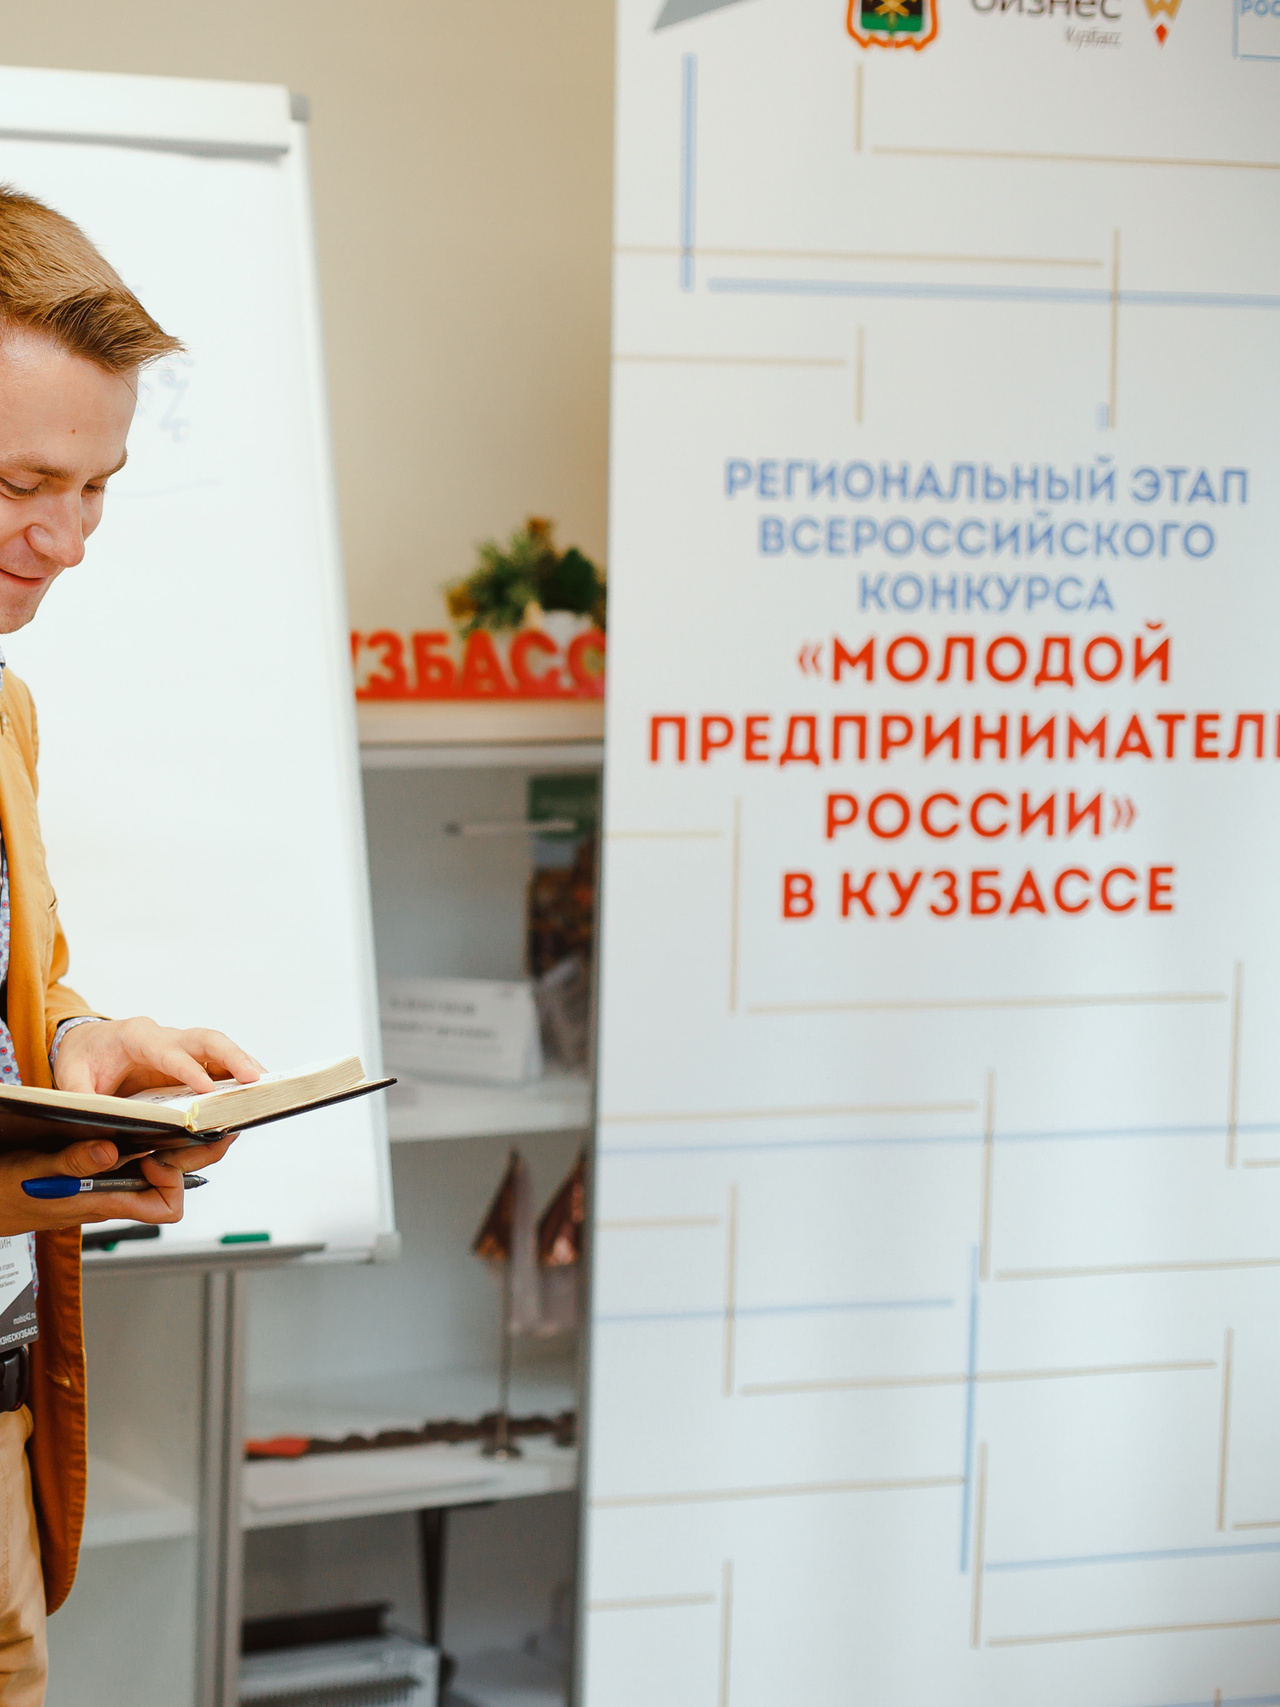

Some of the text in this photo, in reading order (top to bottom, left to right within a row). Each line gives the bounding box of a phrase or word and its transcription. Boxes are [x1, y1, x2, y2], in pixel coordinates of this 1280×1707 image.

[726, 457, 1248, 505] РЕГИОНАЛЬНЫЙ ЭТАП
[760, 511, 1215, 558] ВСЕРОССИЙСКОГО
[860, 575, 1115, 612] КОНКУРСА
[797, 621, 1172, 688] «МОЛОДОЙ
[648, 711, 1280, 769] ПРЕДПРИНИМАТЕЛ
[824, 790, 1136, 842] РОССИИ»
[781, 865, 1175, 921] В КУЗБАССЕ
